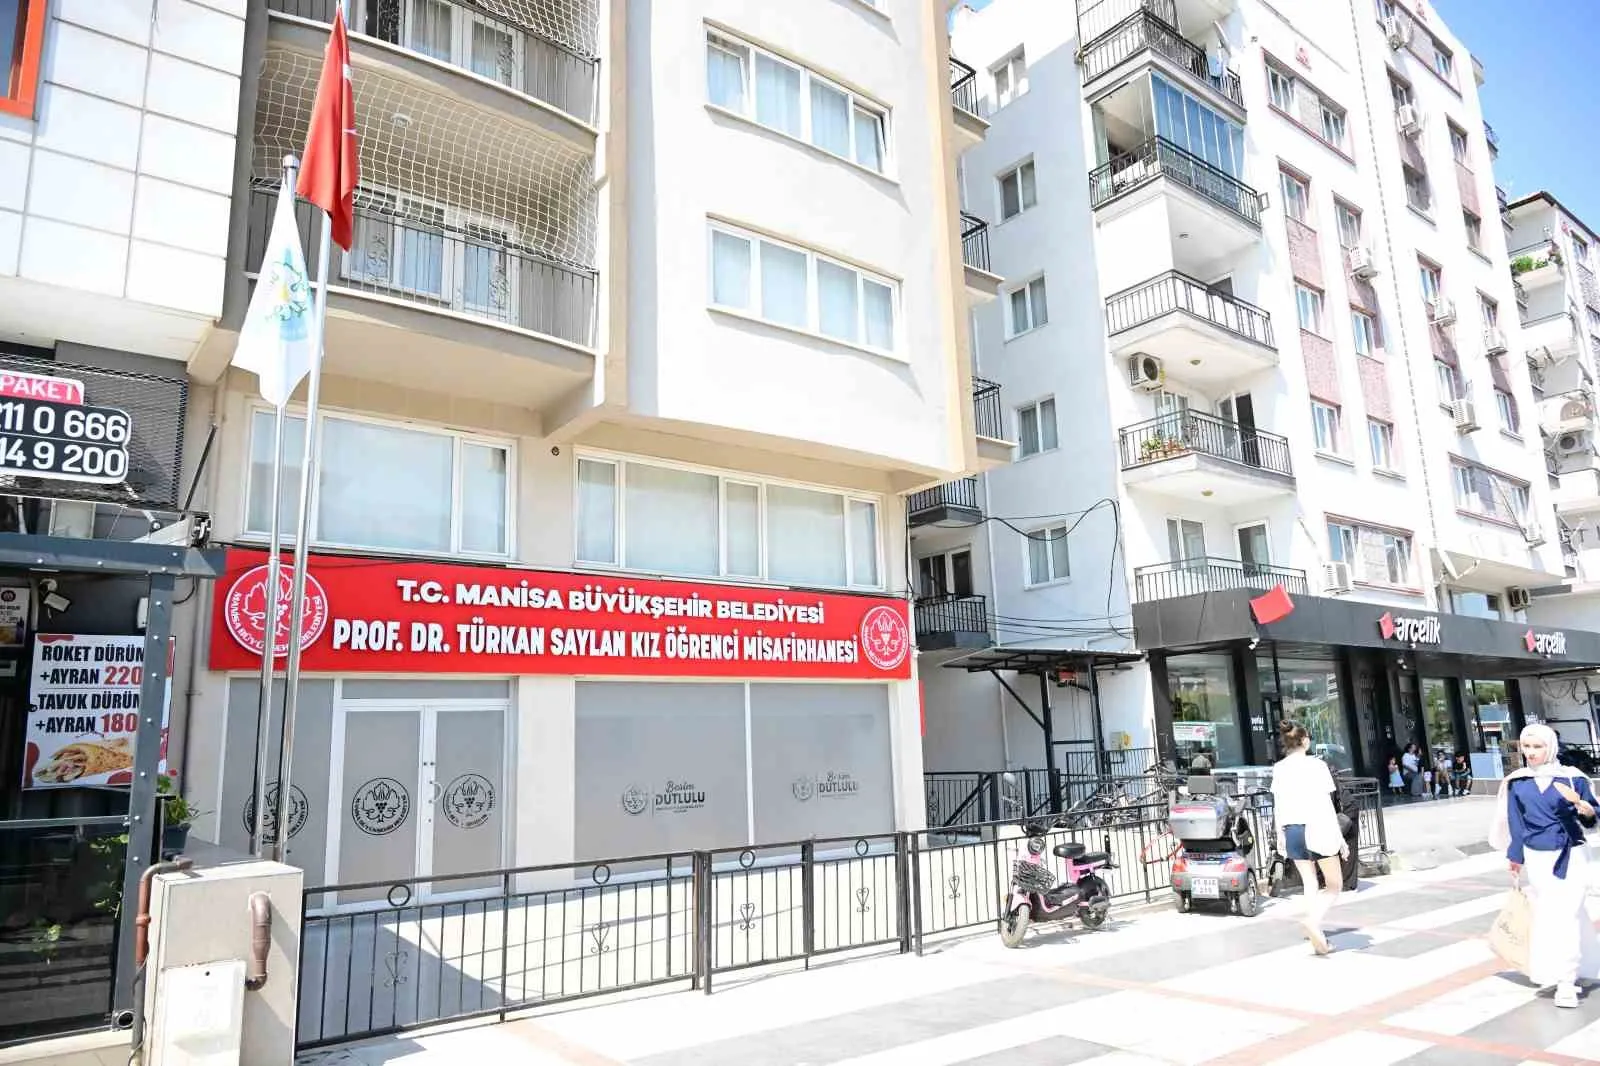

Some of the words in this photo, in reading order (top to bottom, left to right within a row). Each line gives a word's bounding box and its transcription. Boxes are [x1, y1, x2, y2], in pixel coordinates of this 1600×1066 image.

[0, 375, 74, 401] PAKET
[0, 402, 25, 431] 11
[33, 406, 55, 434] 0
[63, 410, 126, 442] 666
[32, 441, 55, 469] 9
[61, 445, 125, 476] 200
[397, 579, 450, 602] T.C.
[455, 580, 563, 611] MANİSA
[569, 584, 713, 619] BÜYÜKŞEHİR
[716, 598, 825, 624] BELEDİYESİ
[333, 617, 404, 652] PROF.
[410, 621, 451, 653] DR.
[456, 616, 546, 656] TÜRKAN
[550, 626, 626, 658] SAYLAN
[631, 631, 660, 658] KIZ
[665, 626, 739, 661] ÖĞRENCİ
[743, 629, 859, 664] MİSAFİRHANESİ
[1394, 616, 1441, 649] arçelik
[1535, 631, 1566, 659] arçelik
[41, 645, 91, 662] ROKET
[40, 667, 100, 685] +AYRAN
[103, 665, 143, 686] 220
[37, 693, 88, 711] TAVUK
[35, 716, 97, 734] +AYRAN
[101, 712, 138, 733] 180
[655, 791, 705, 805] DUTLULU
